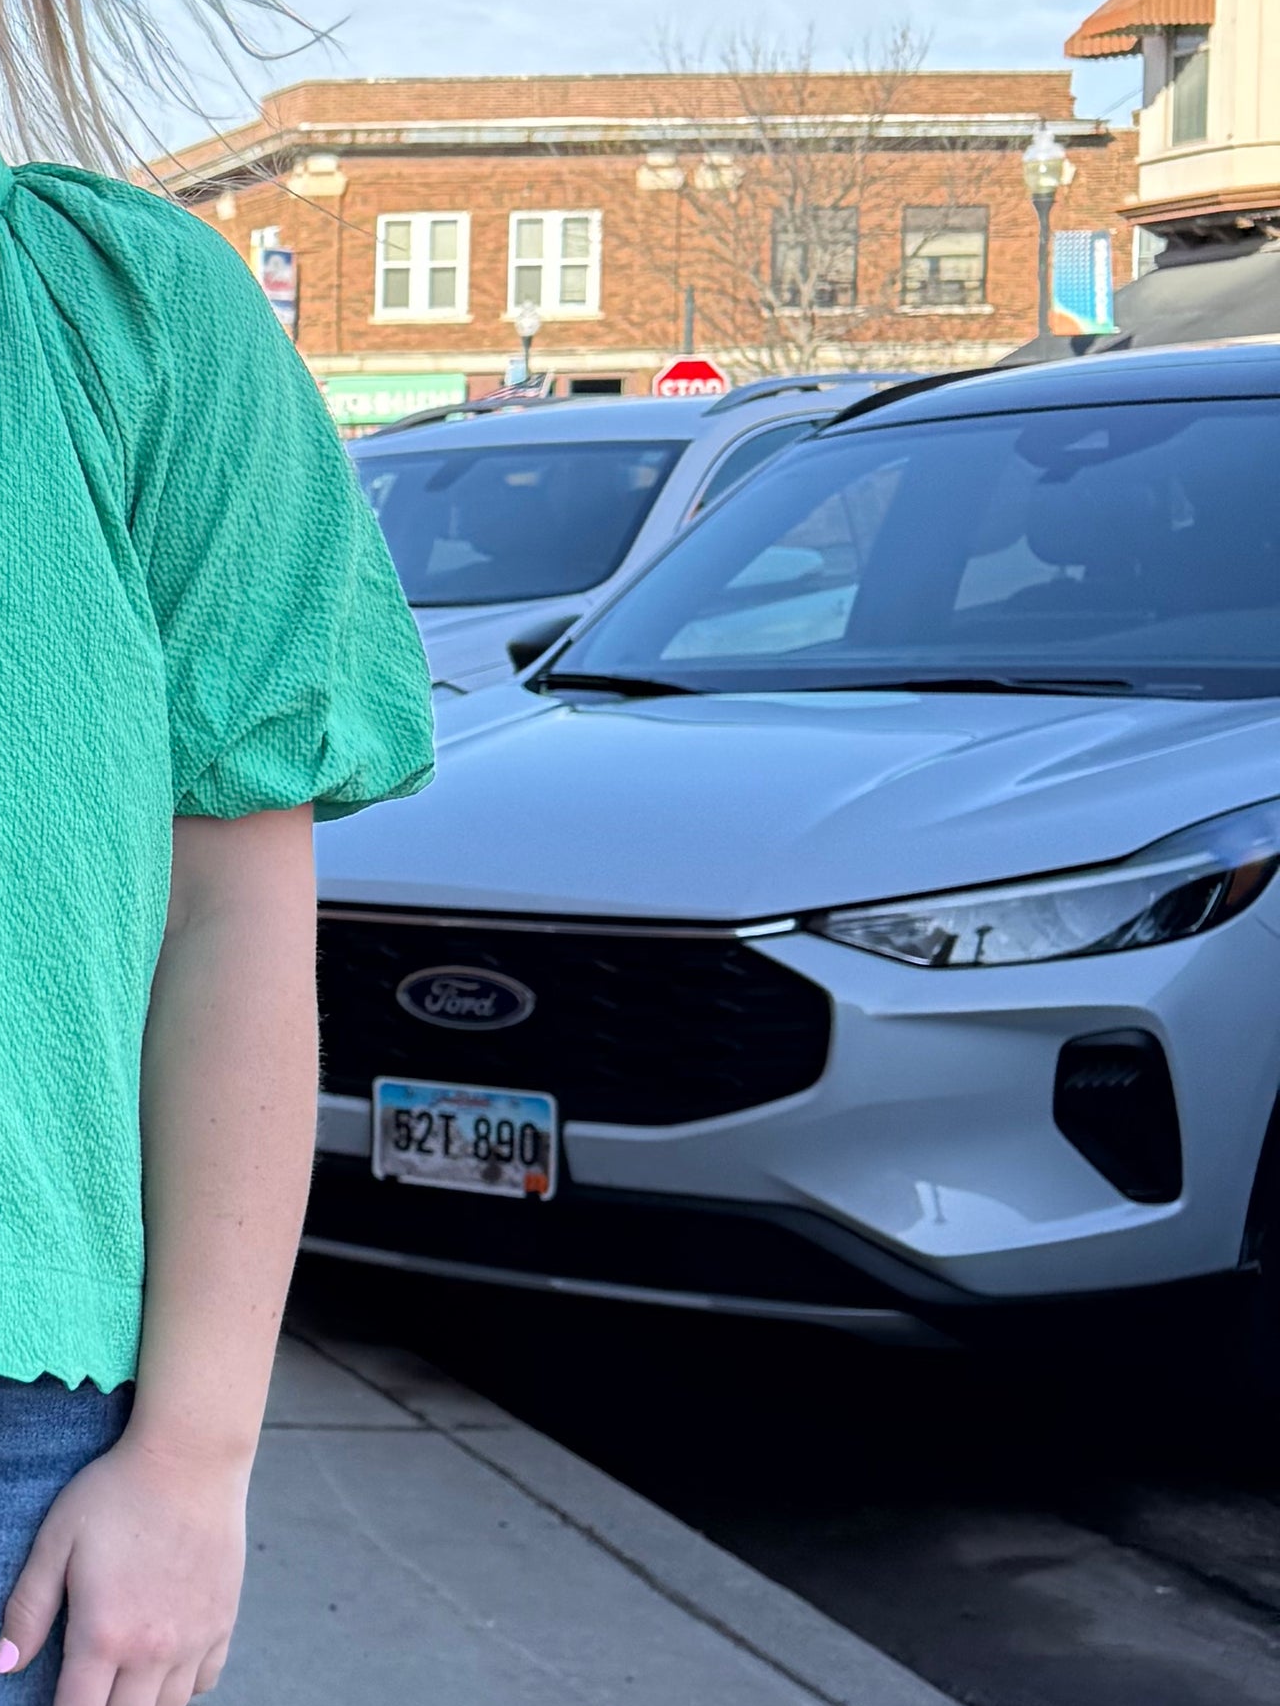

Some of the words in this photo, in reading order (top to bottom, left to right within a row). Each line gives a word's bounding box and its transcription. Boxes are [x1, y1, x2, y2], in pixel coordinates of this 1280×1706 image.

[424, 979, 497, 1017] Ford
[393, 1109, 456, 1156] 52T
[473, 1115, 540, 1165] 890
